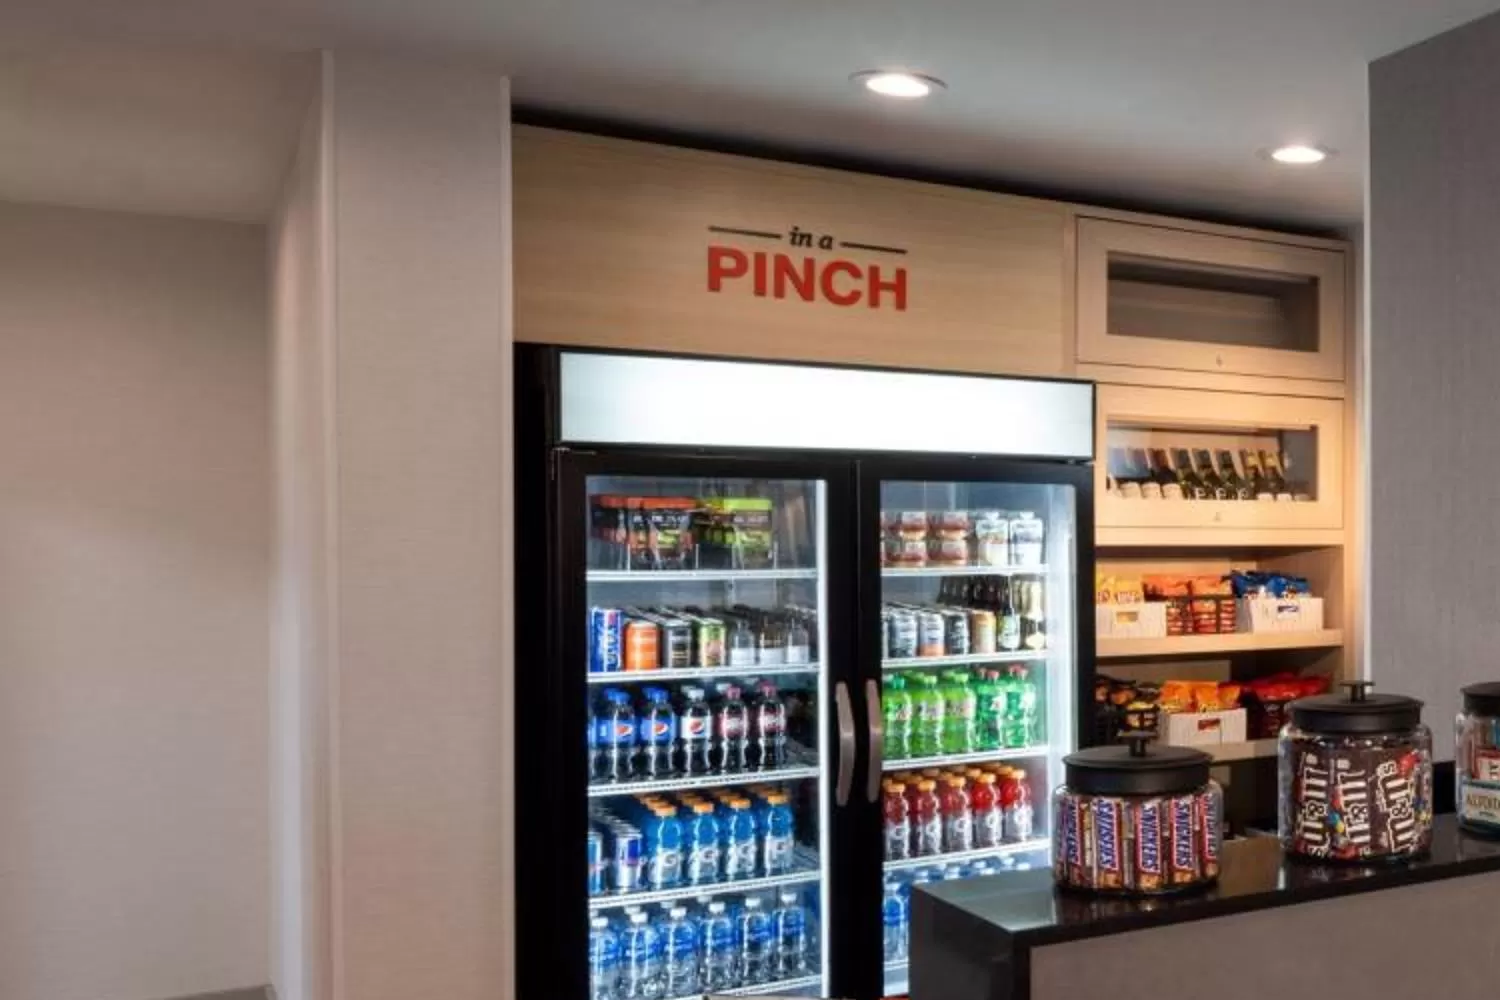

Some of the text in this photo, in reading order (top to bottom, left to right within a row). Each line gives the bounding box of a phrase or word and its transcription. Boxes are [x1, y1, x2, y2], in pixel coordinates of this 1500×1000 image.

[789, 226, 833, 250] in a
[707, 245, 907, 312] PINCH
